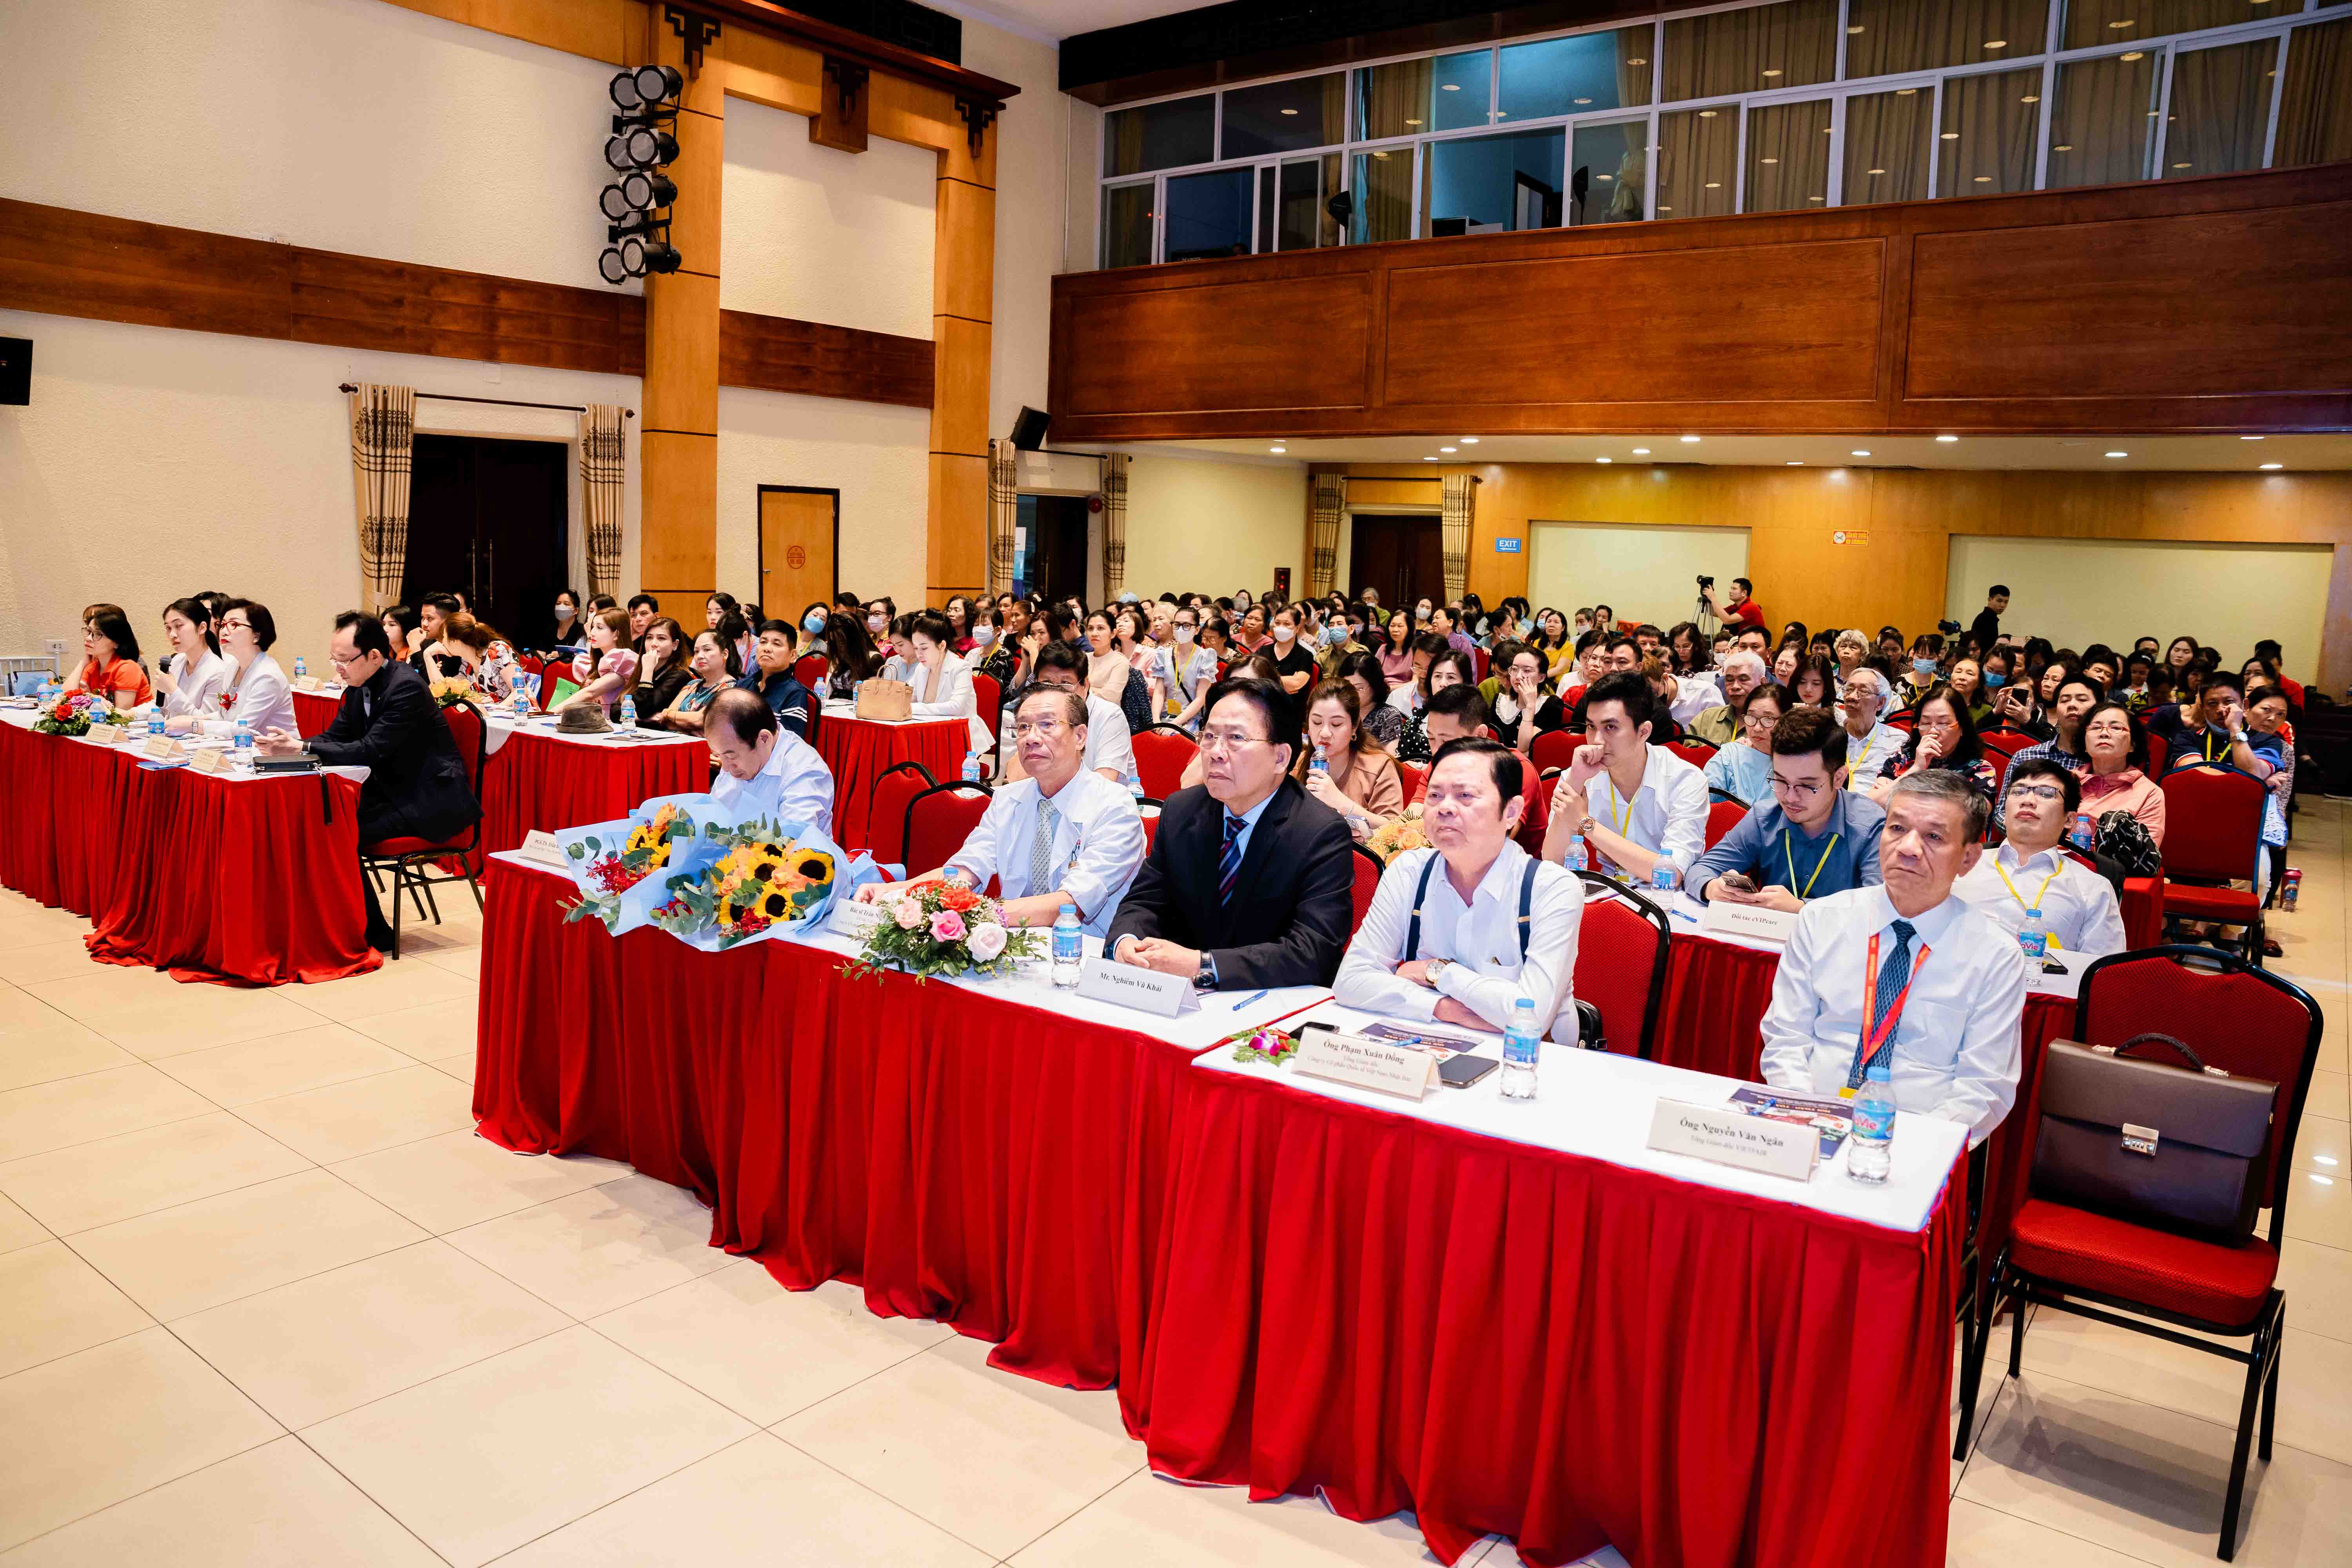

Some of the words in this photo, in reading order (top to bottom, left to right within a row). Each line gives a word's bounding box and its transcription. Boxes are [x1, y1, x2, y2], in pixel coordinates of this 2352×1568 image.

[1752, 916, 1778, 925] eVIPcare
[2020, 942, 2039, 950] aVie
[1100, 972, 1110, 981] Mr.
[1112, 975, 1134, 986] Nghiêm
[1324, 1039, 1339, 1051] Ông
[1341, 1044, 1361, 1054] Phạm
[1363, 1048, 1383, 1059] Xuân
[1680, 1116, 1699, 1131] Ông
[1702, 1122, 1735, 1137] Nguyễn
[1737, 1130, 1757, 1141] Văn
